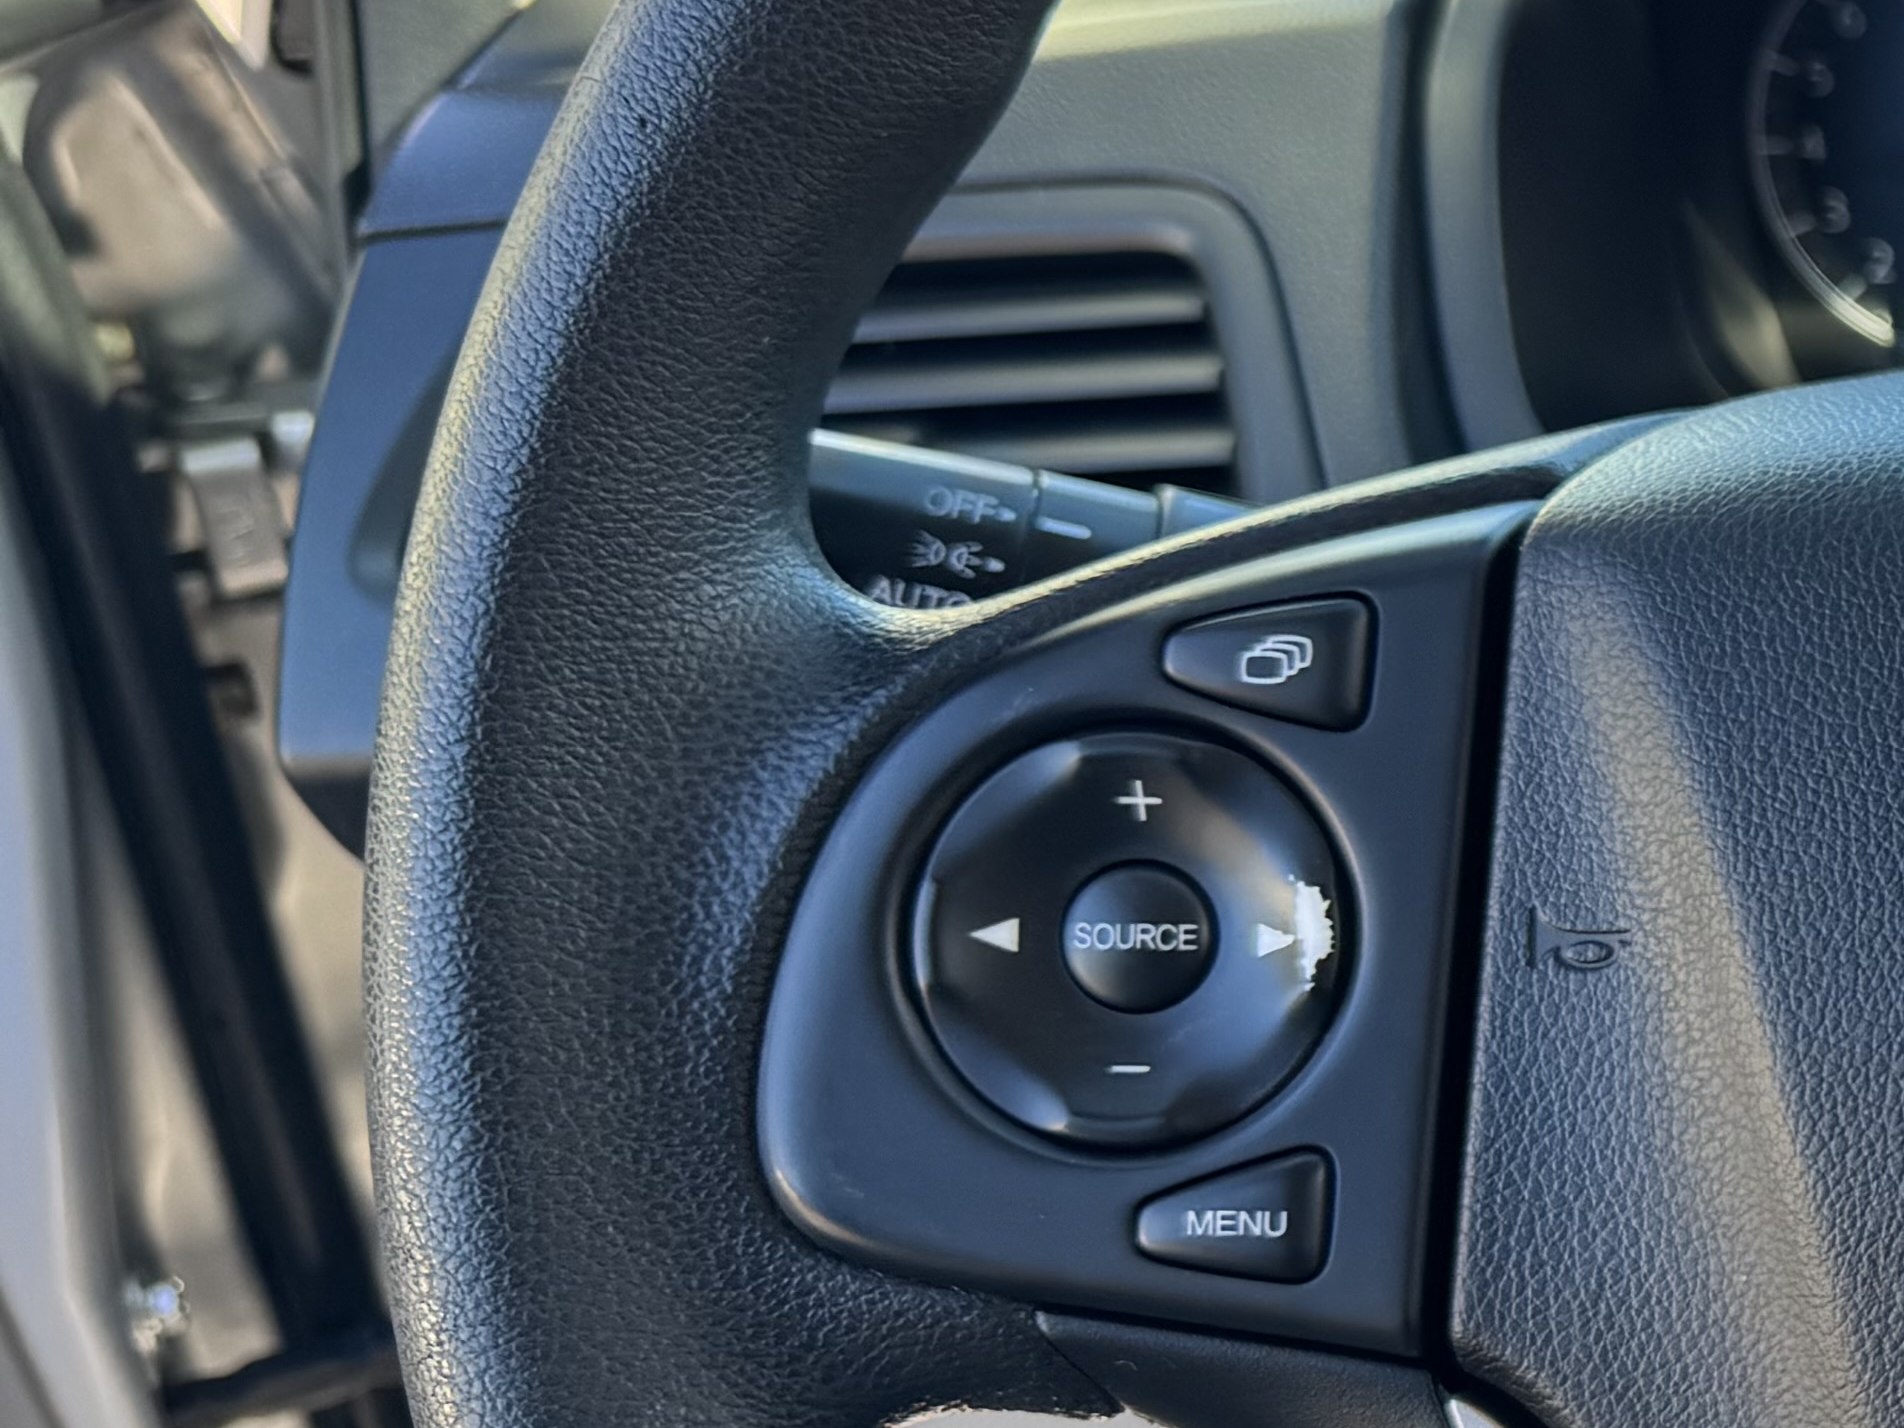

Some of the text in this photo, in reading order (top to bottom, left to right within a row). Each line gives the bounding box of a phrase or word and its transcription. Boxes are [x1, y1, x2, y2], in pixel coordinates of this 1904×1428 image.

[925, 484, 999, 524] OFF
[1073, 920, 1199, 953] SOURCE
[1185, 1209, 1289, 1240] MENU
